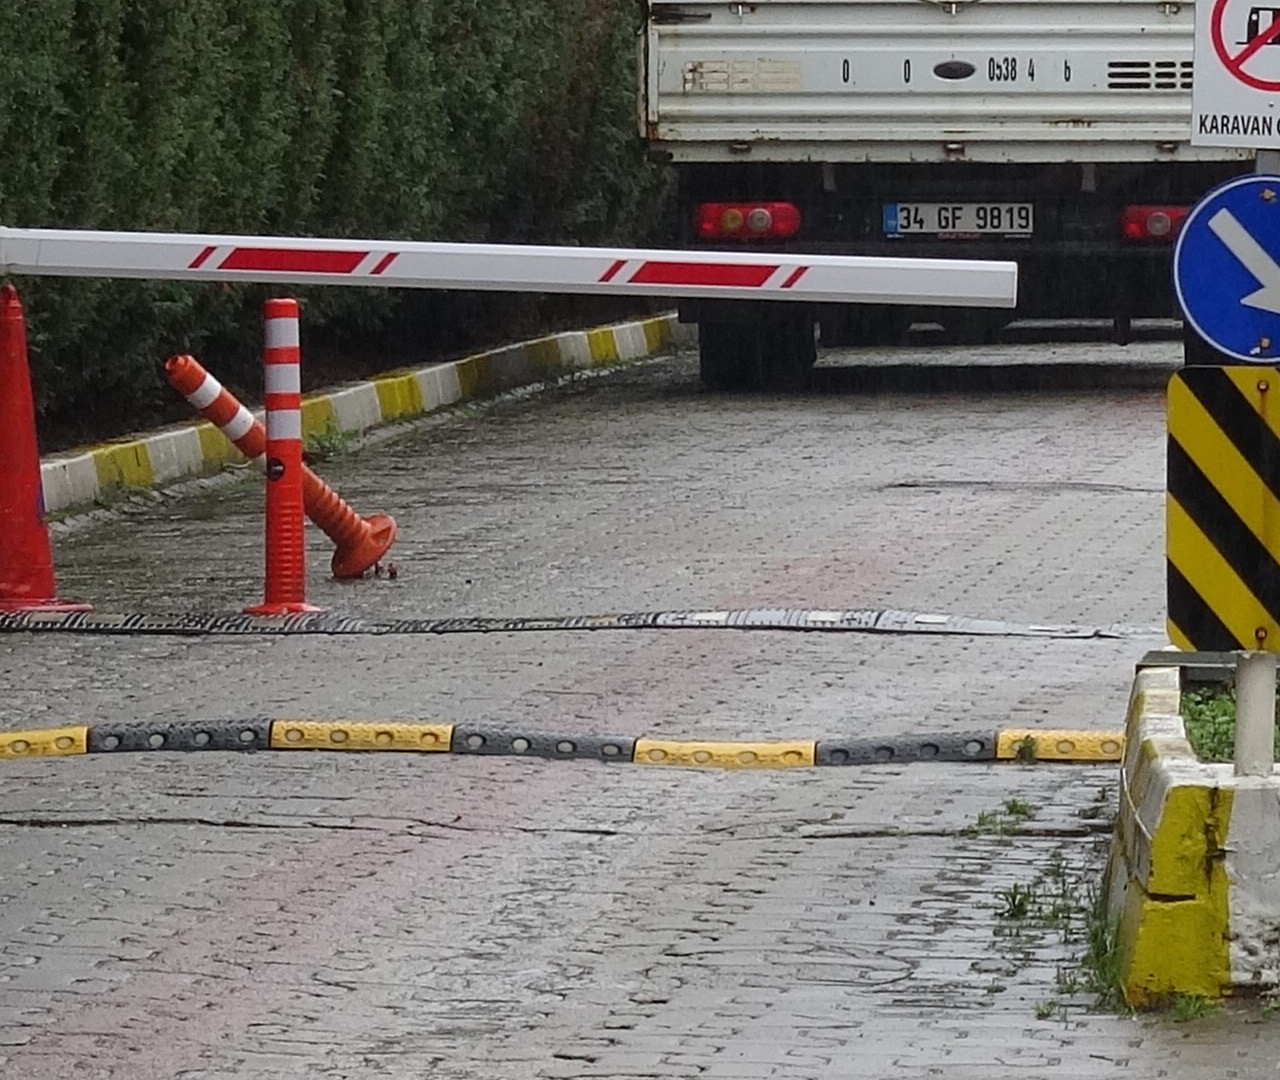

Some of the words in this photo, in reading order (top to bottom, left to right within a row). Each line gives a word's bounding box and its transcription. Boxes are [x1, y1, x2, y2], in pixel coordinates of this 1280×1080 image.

[1199, 114, 1272, 136] KARAVAN
[900, 207, 925, 229] 34
[938, 207, 963, 229] GF
[976, 207, 1030, 229] 9819
